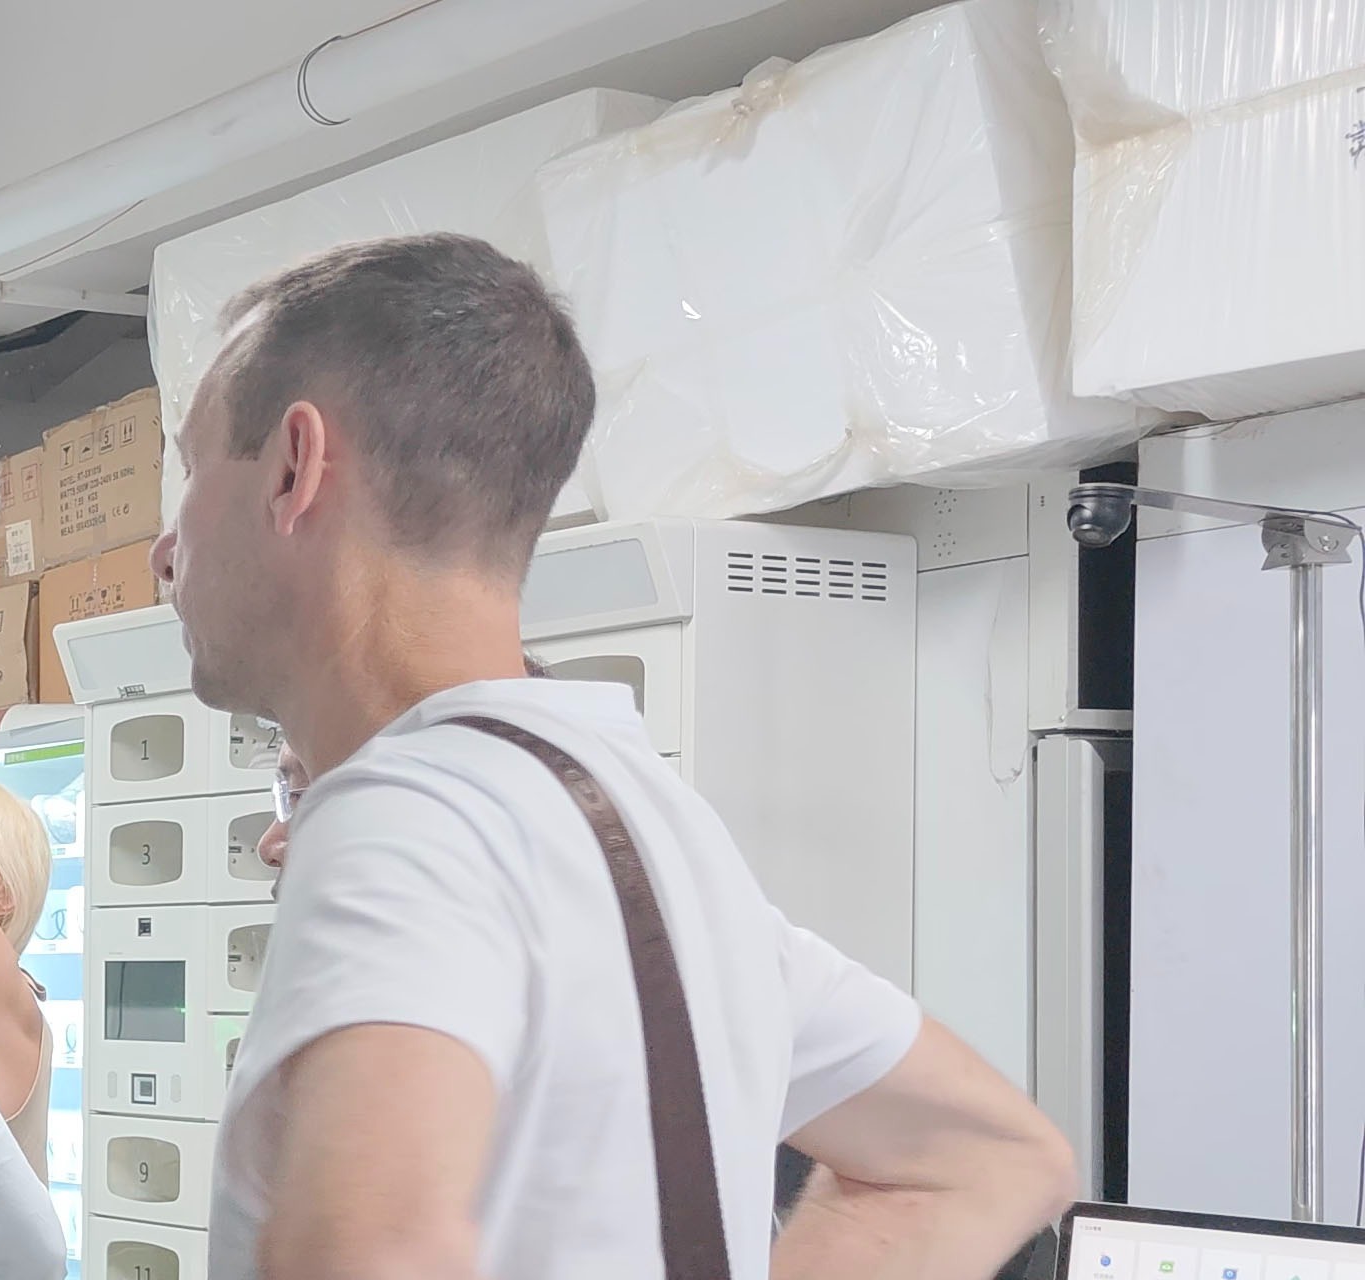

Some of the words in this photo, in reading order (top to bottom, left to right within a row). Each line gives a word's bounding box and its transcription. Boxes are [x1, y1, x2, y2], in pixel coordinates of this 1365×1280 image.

[267, 727, 278, 750] 2
[141, 740, 150, 761] 1
[141, 844, 152, 866] 3
[139, 1162, 149, 1183] 9
